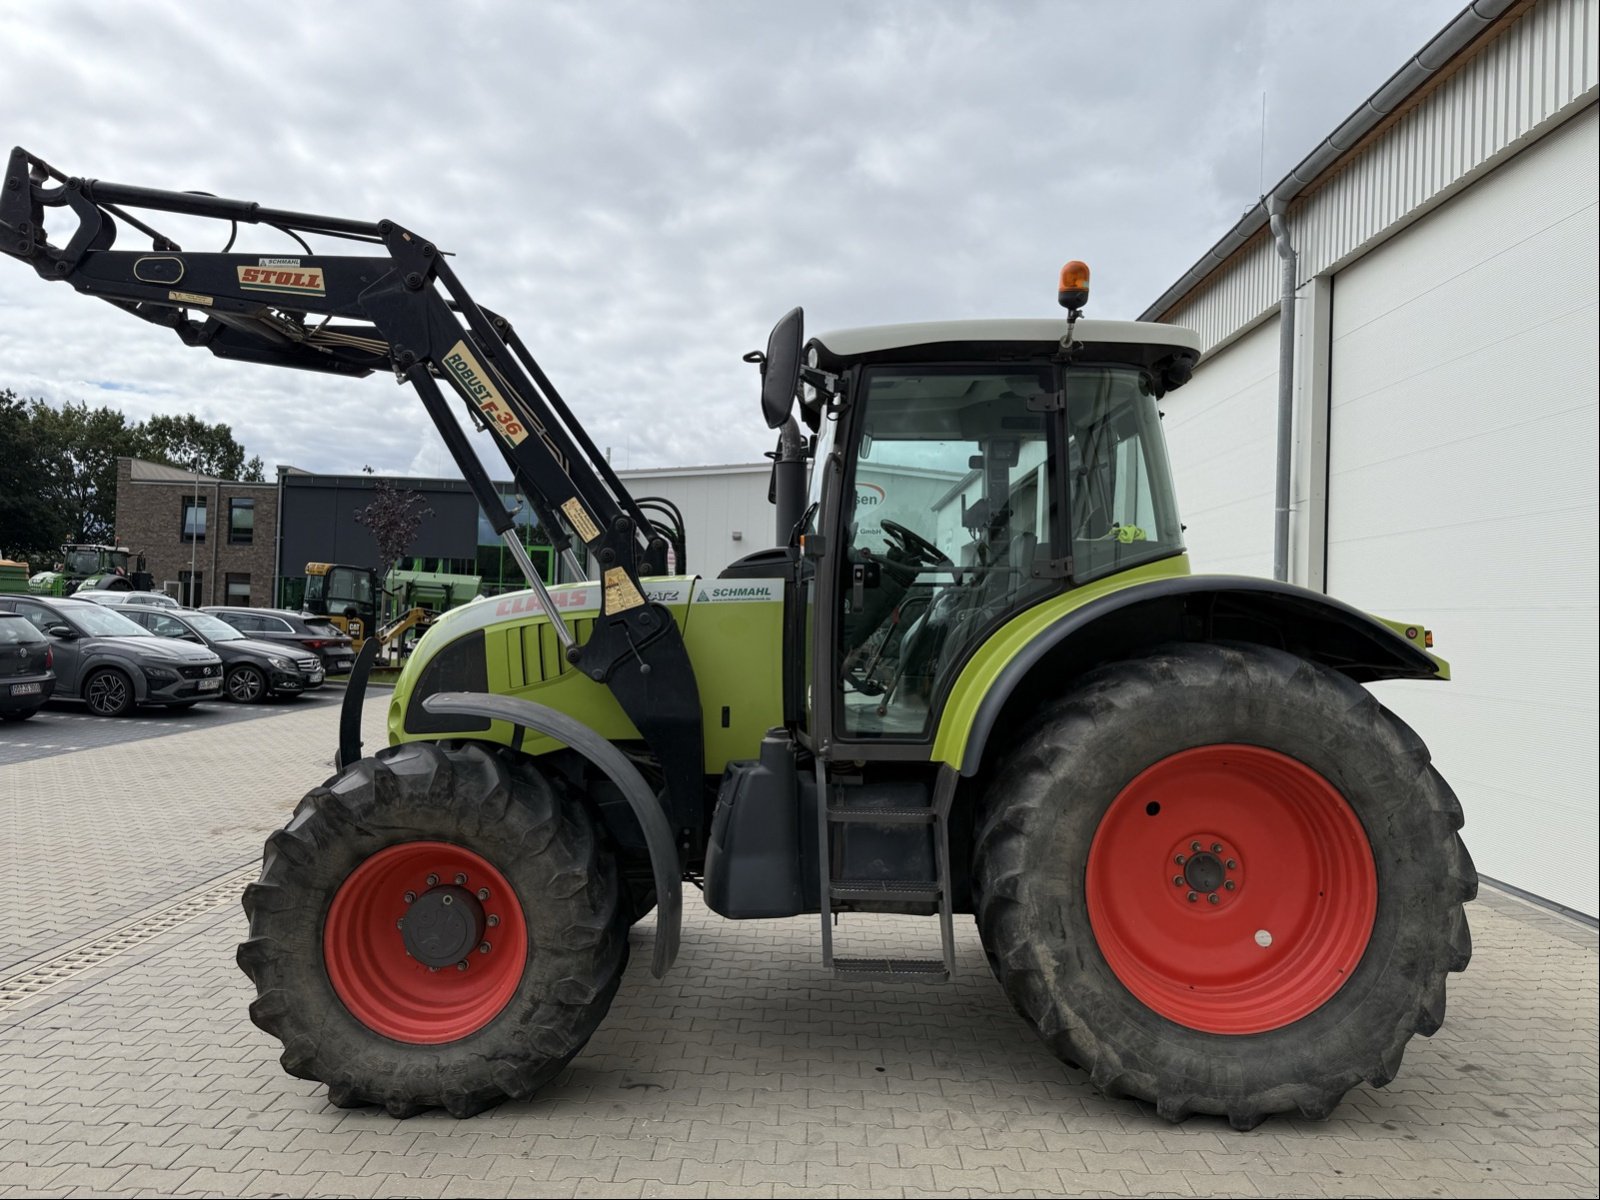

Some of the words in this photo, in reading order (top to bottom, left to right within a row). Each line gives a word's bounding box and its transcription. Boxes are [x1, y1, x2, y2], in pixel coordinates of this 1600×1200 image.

[242, 268, 321, 288] STOLL
[448, 353, 493, 400] ROBUST
[712, 587, 771, 597] SCHMAHL
